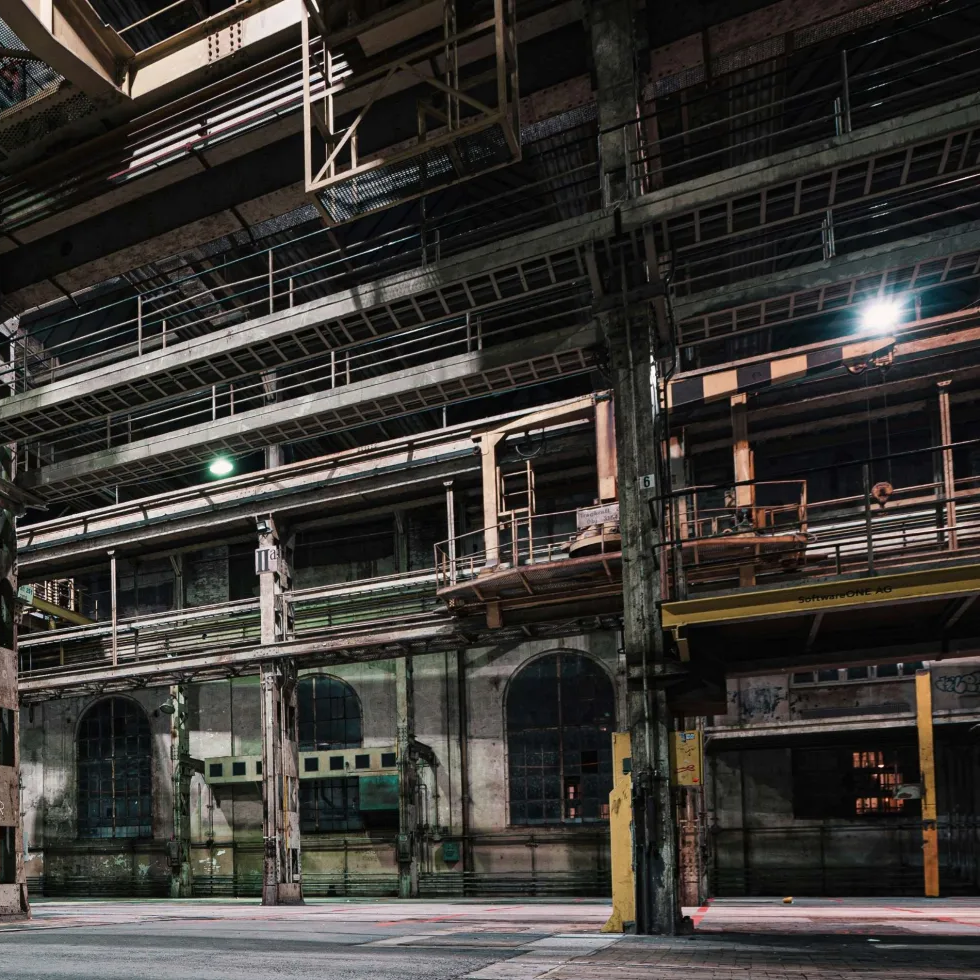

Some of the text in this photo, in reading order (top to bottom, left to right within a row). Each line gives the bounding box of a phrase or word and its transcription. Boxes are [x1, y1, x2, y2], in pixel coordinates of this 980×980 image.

[643, 476, 651, 488] 6
[798, 585, 892, 604] SoftwareONE AG
